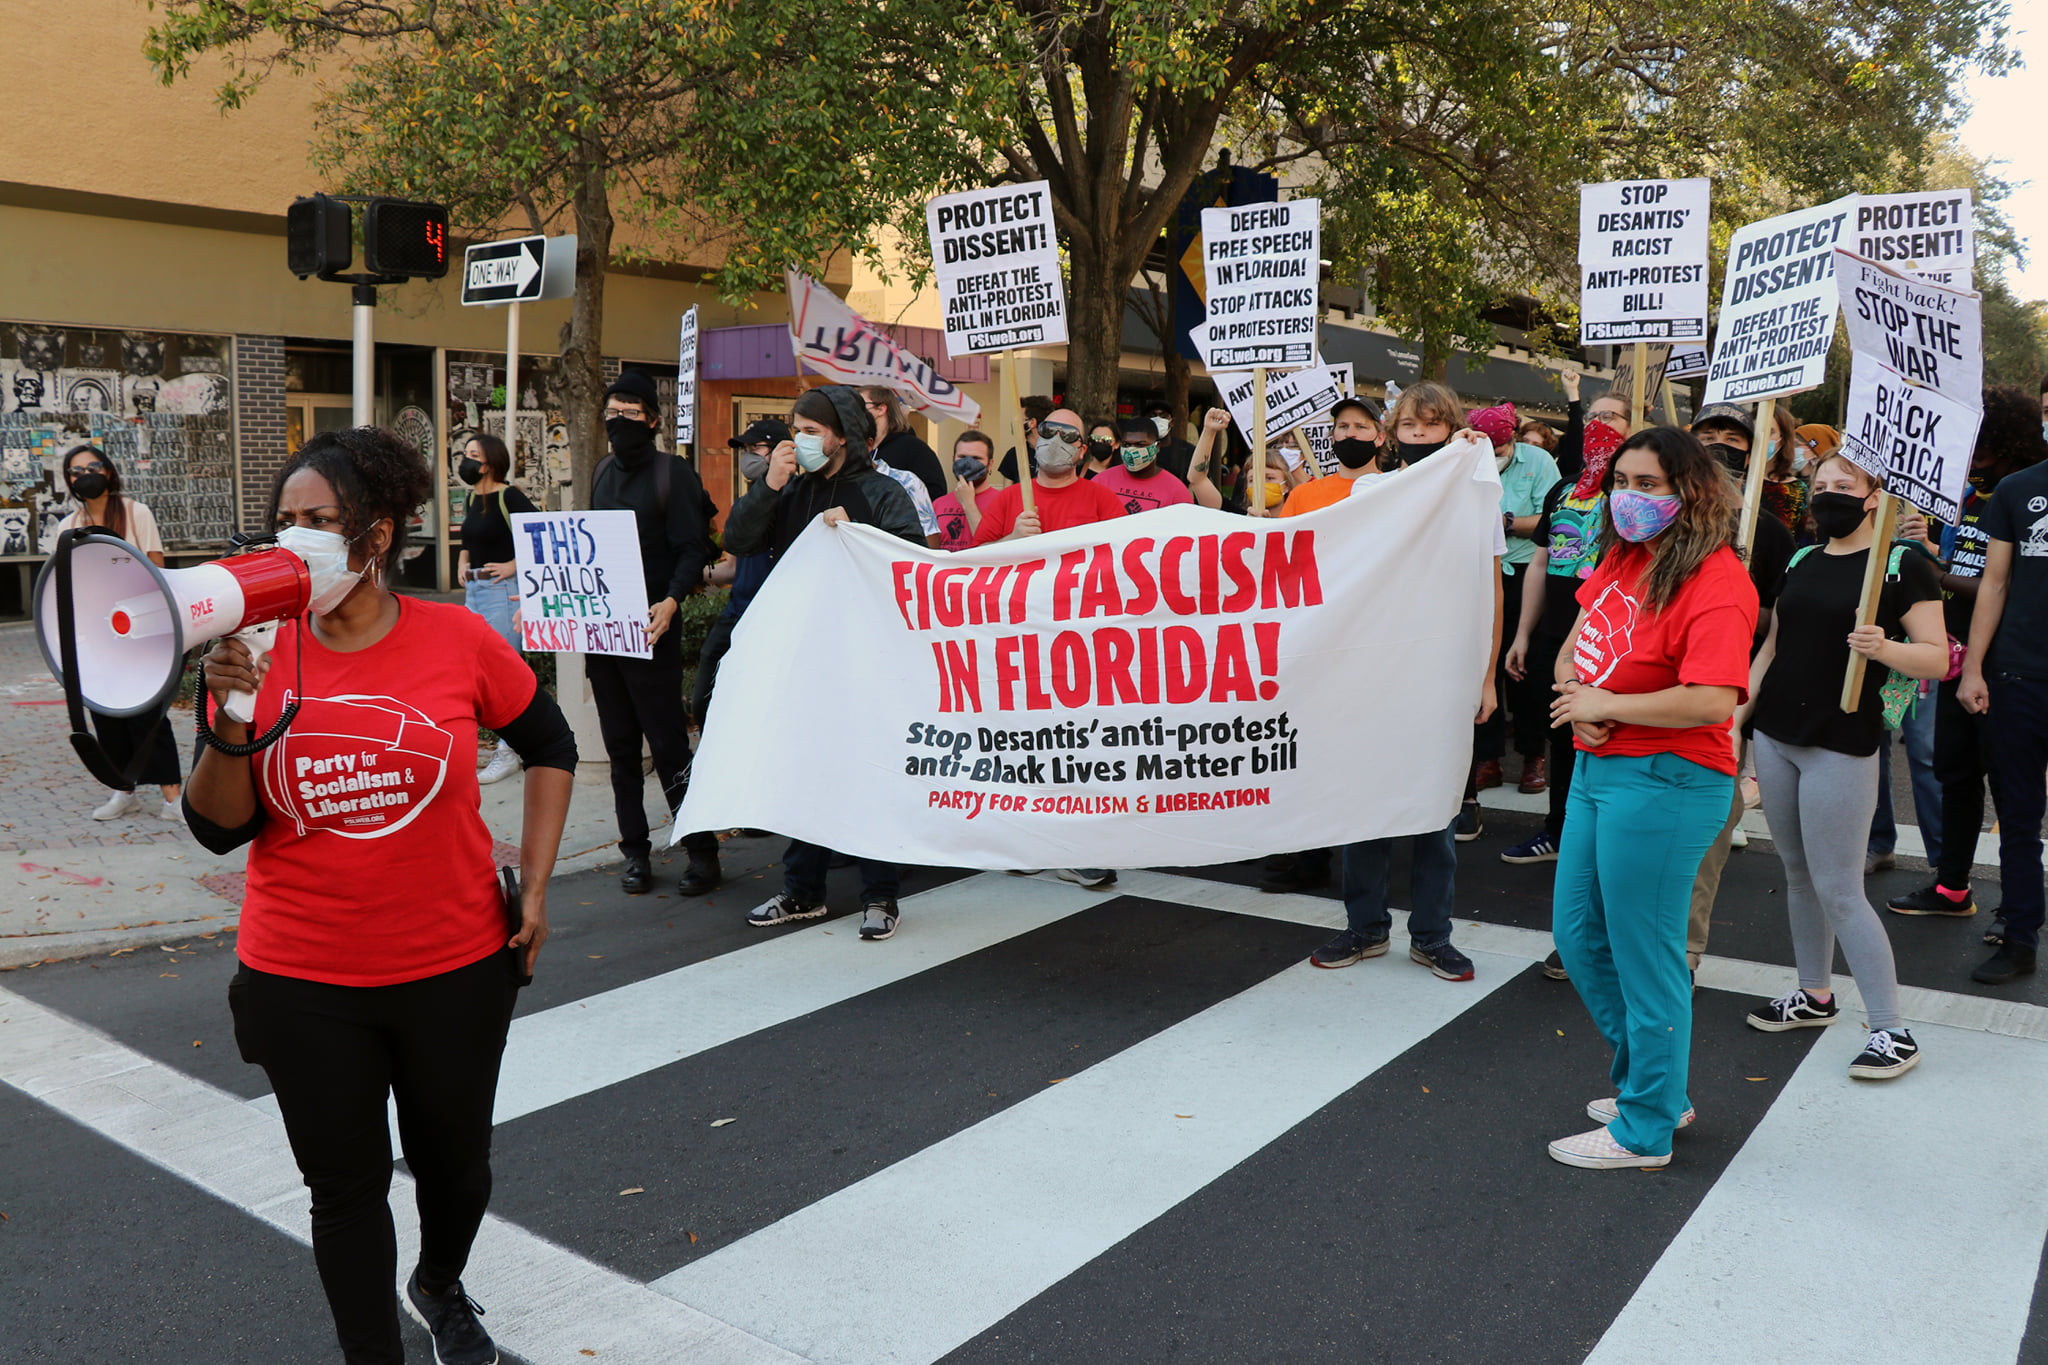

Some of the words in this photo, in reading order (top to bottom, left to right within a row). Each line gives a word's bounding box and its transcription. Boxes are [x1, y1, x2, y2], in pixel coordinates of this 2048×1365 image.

[1620, 184, 1668, 206] STOP
[938, 191, 1042, 233] PROTECT
[1231, 206, 1290, 232] DEFEND
[1597, 209, 1690, 233] DESANTIS'
[1858, 198, 1962, 231] PROTECT
[426, 219, 442, 263] 4
[943, 223, 1047, 264] DISSENT!
[1209, 239, 1248, 261] FREE
[1252, 230, 1312, 255] SPEECH
[1611, 237, 1672, 257] RACIST
[1735, 212, 1847, 272] PROTECT
[1859, 229, 1963, 261] DISSENT!
[472, 263, 493, 286] ONE
[496, 259, 519, 283] WAY
[957, 271, 1008, 295] DEFEAT
[1012, 265, 1040, 285] THE
[1217, 265, 1233, 285] IN
[1236, 257, 1306, 282] FLORIDA!
[1586, 264, 1703, 289] ANTI-PROTEST
[1730, 250, 1834, 306] DISSENT!
[949, 282, 1053, 314] ANTI-PROTEST
[1210, 295, 1246, 316] STOP
[1249, 287, 1313, 311] ATTACKS
[1623, 292, 1664, 312] BILL!
[1860, 266, 1900, 299] Fight
[1905, 284, 1957, 315] back!
[946, 313, 978, 333] BILL
[981, 310, 993, 328] IN
[995, 300, 1060, 326] FLORIDA!
[1209, 325, 1226, 342] ON
[1229, 316, 1314, 340] PROTESTERS!
[1588, 321, 1669, 338] PSLweb.org
[1731, 304, 1788, 338] DEFEAT
[1790, 296, 1821, 323] THE
[1855, 286, 1909, 337] STOP
[1912, 311, 1963, 360] THE
[969, 326, 1042, 349] PSLweb.org
[1717, 314, 1829, 360] ANTI-PROTEST
[1212, 346, 1283, 365] PSLweb.org
[1709, 359, 1739, 381] BILL
[1742, 354, 1757, 374] IN
[1760, 335, 1830, 369] FLORIDA!
[1885, 332, 1940, 387] WAR
[1265, 381, 1300, 410] BILL!
[1726, 369, 1801, 398] PSLweb.org
[1876, 383, 1942, 448] BLACK
[1861, 411, 1944, 492] AMERICA
[1887, 475, 1956, 523] PSLWEB.ORG
[892, 558, 1046, 631] FIGHT
[1053, 529, 1324, 622] FASCISM
[190, 598, 213, 620] PYLE
[541, 592, 612, 619] HATES
[931, 638, 983, 713] IN
[995, 621, 1281, 713] FLORIDA!
[905, 721, 972, 757] Stop
[978, 717, 1098, 753] Desantis'
[1101, 711, 1298, 751] anti-protest,
[295, 753, 356, 779] Party
[361, 751, 378, 768] for
[904, 753, 1046, 784] anti-Black
[1052, 753, 1127, 784] Lives
[1136, 753, 1245, 782] Matter
[1251, 740, 1298, 773] bill
[298, 770, 401, 800] Socialism
[404, 767, 415, 784] &
[304, 791, 409, 818] Liberation
[928, 790, 986, 820] PARTY
[989, 793, 1027, 812] FOR
[1031, 794, 1129, 815] SOCIALISM
[1135, 794, 1151, 814] &
[1155, 786, 1272, 813] LIBERATION
